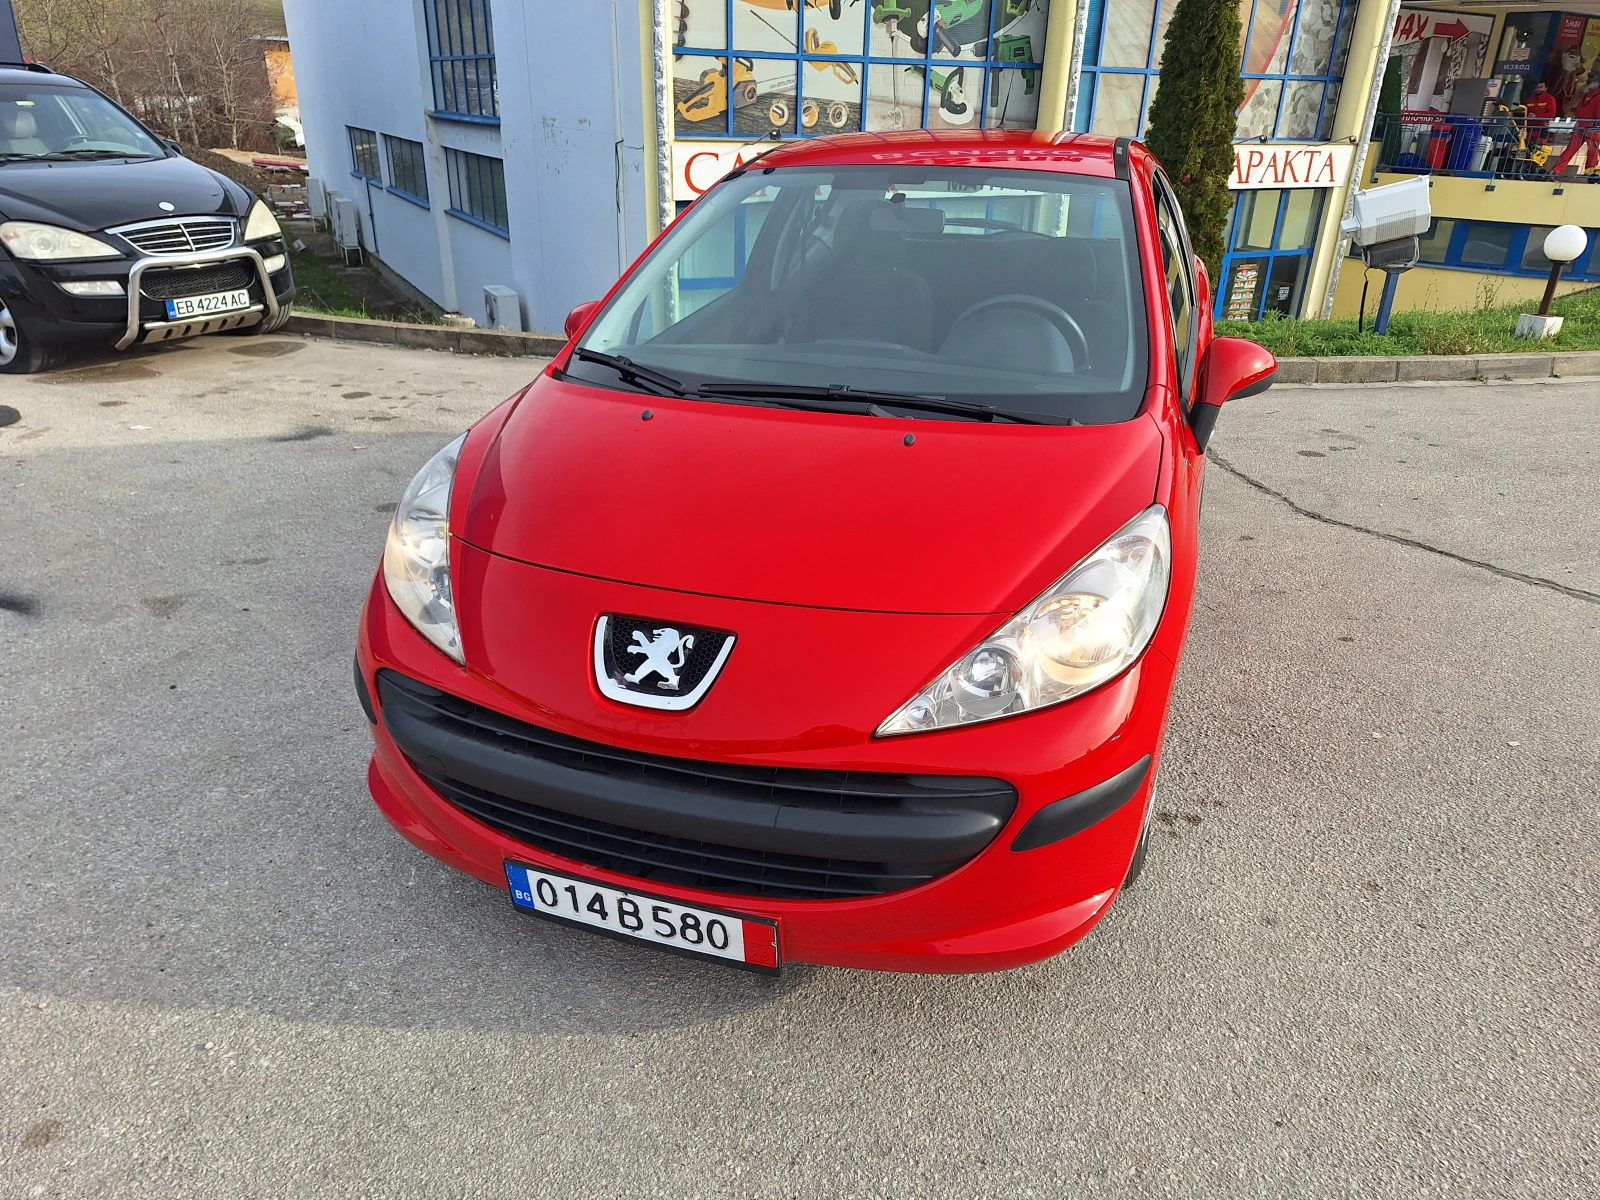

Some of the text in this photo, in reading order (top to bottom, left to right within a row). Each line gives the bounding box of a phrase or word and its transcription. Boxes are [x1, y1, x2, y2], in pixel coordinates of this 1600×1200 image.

[176, 292, 247, 315] EB 4224 AC
[515, 889, 531, 902] BG
